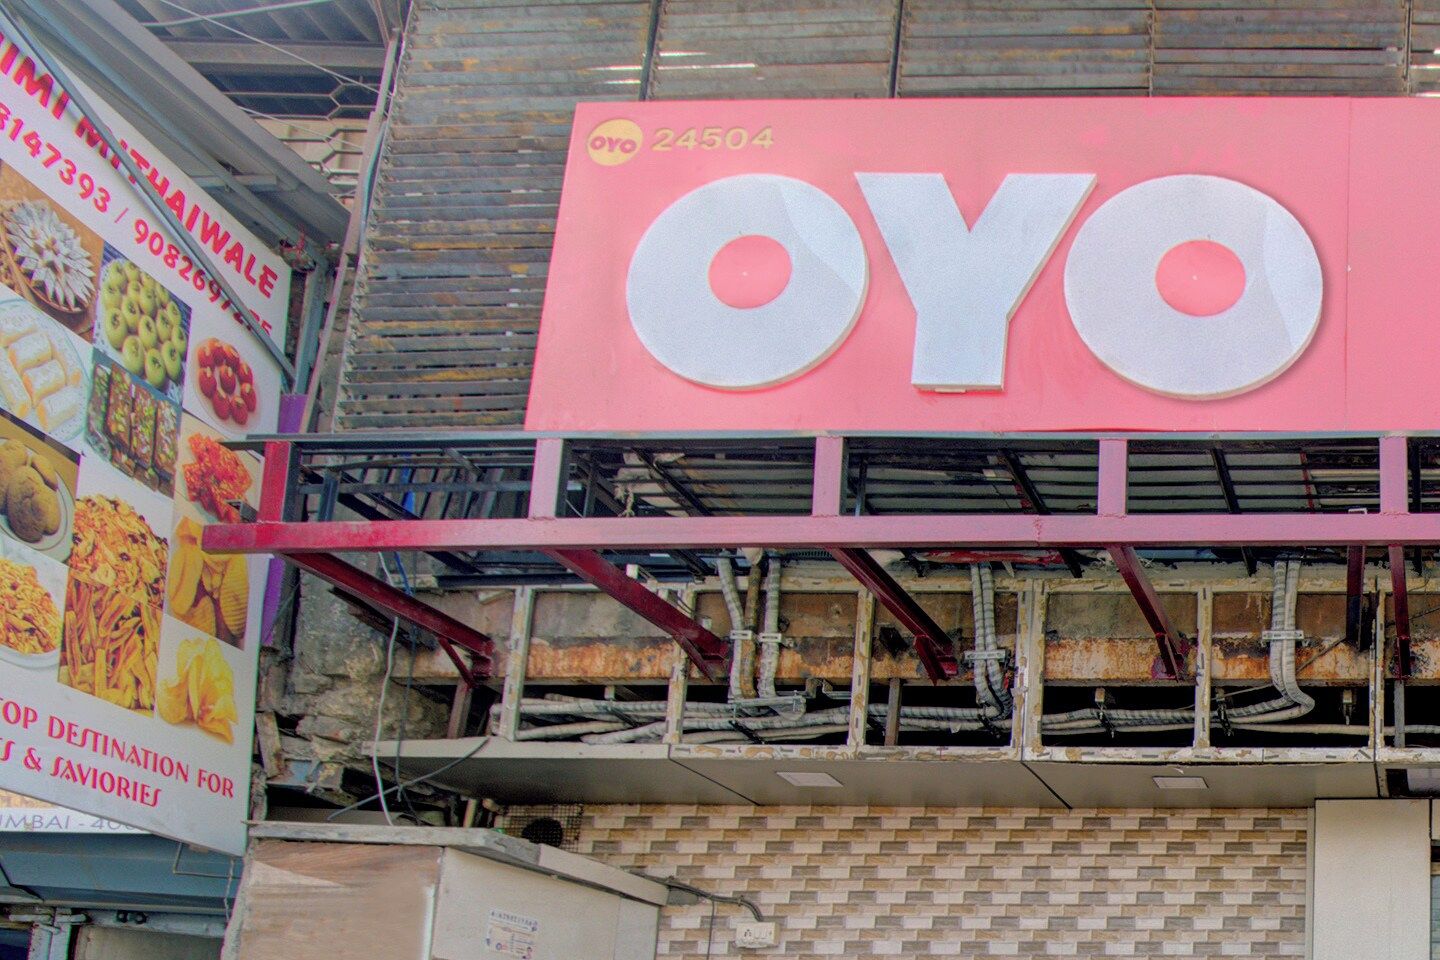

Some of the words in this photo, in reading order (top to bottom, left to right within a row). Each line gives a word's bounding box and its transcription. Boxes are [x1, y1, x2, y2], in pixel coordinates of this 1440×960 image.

[0, 31, 70, 120] IMI
[590, 136, 637, 154] OYO
[652, 126, 773, 151] 24504
[626, 172, 1324, 400] OYO
[0, 697, 38, 729] OP
[48, 715, 189, 783] DESTINATION
[197, 768, 234, 799] FOR
[0, 737, 16, 761] S
[23, 746, 42, 772] &
[50, 756, 162, 807] SAVIORIES
[0, 814, 70, 829] MBAI
